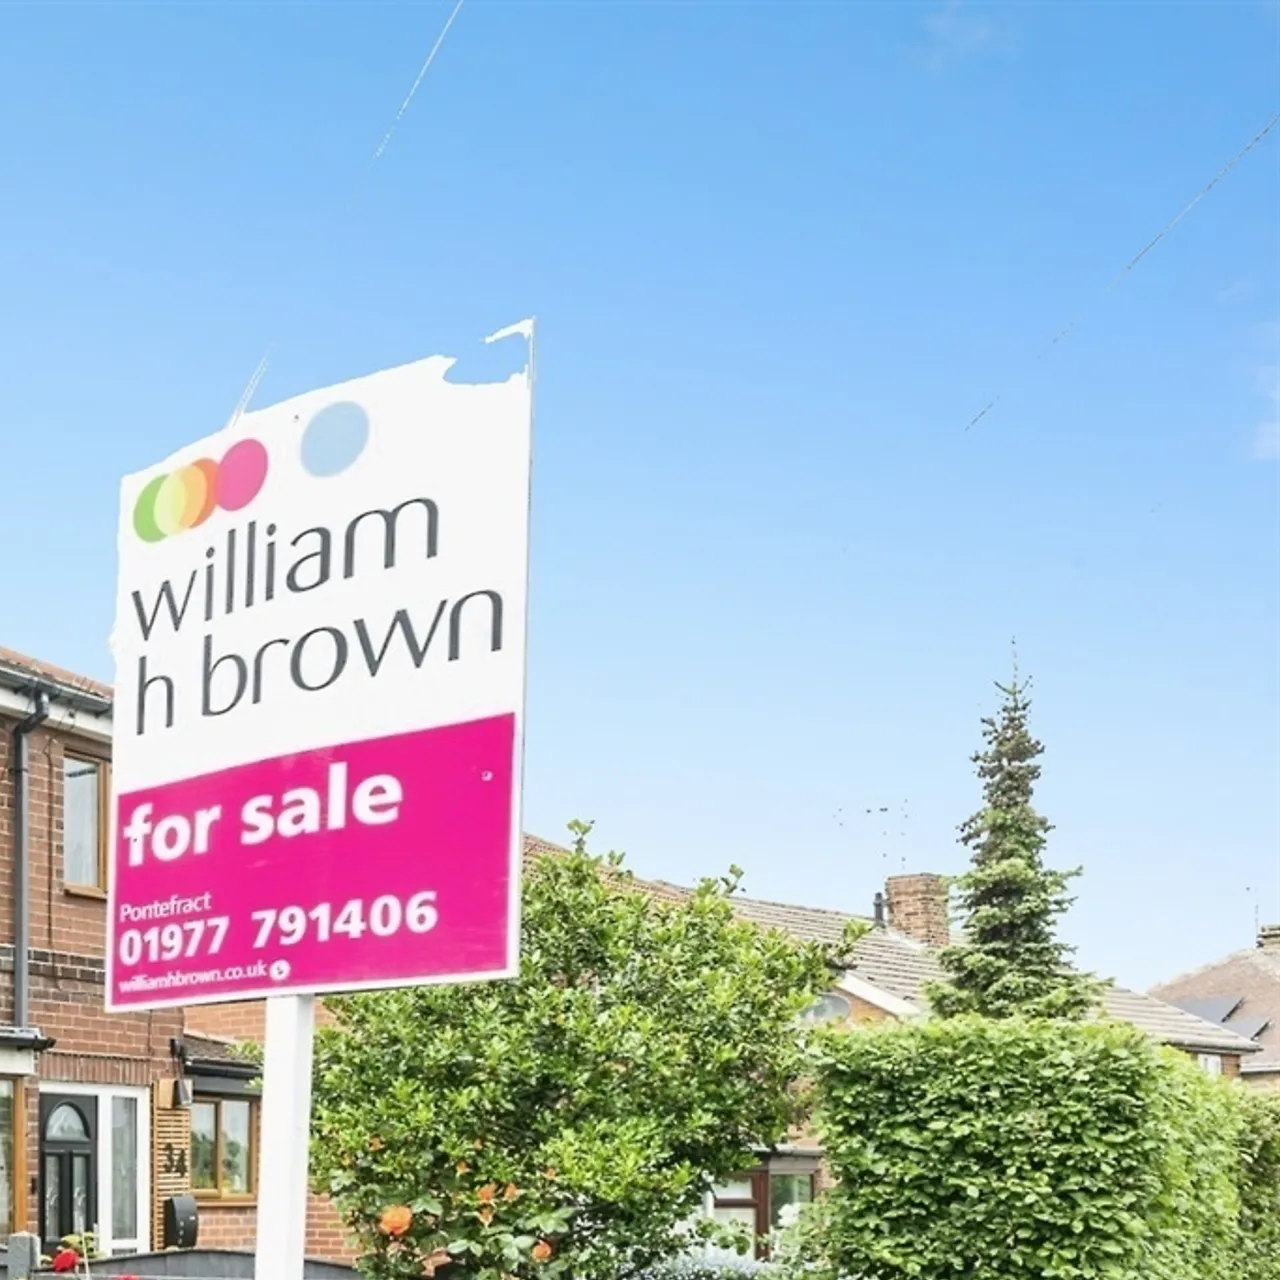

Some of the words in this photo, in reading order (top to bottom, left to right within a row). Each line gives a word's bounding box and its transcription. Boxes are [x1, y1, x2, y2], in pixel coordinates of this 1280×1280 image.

[131, 497, 439, 642] william
[136, 655, 175, 736] h
[201, 589, 504, 717] brown
[123, 802, 222, 867] for
[240, 761, 404, 846] sale
[118, 915, 231, 967] 01977
[251, 890, 439, 949] 791406
[119, 892, 212, 923] Pontefract
[118, 959, 268, 993] williamhbrown.co.uk
[162, 1142, 188, 1178] 34
